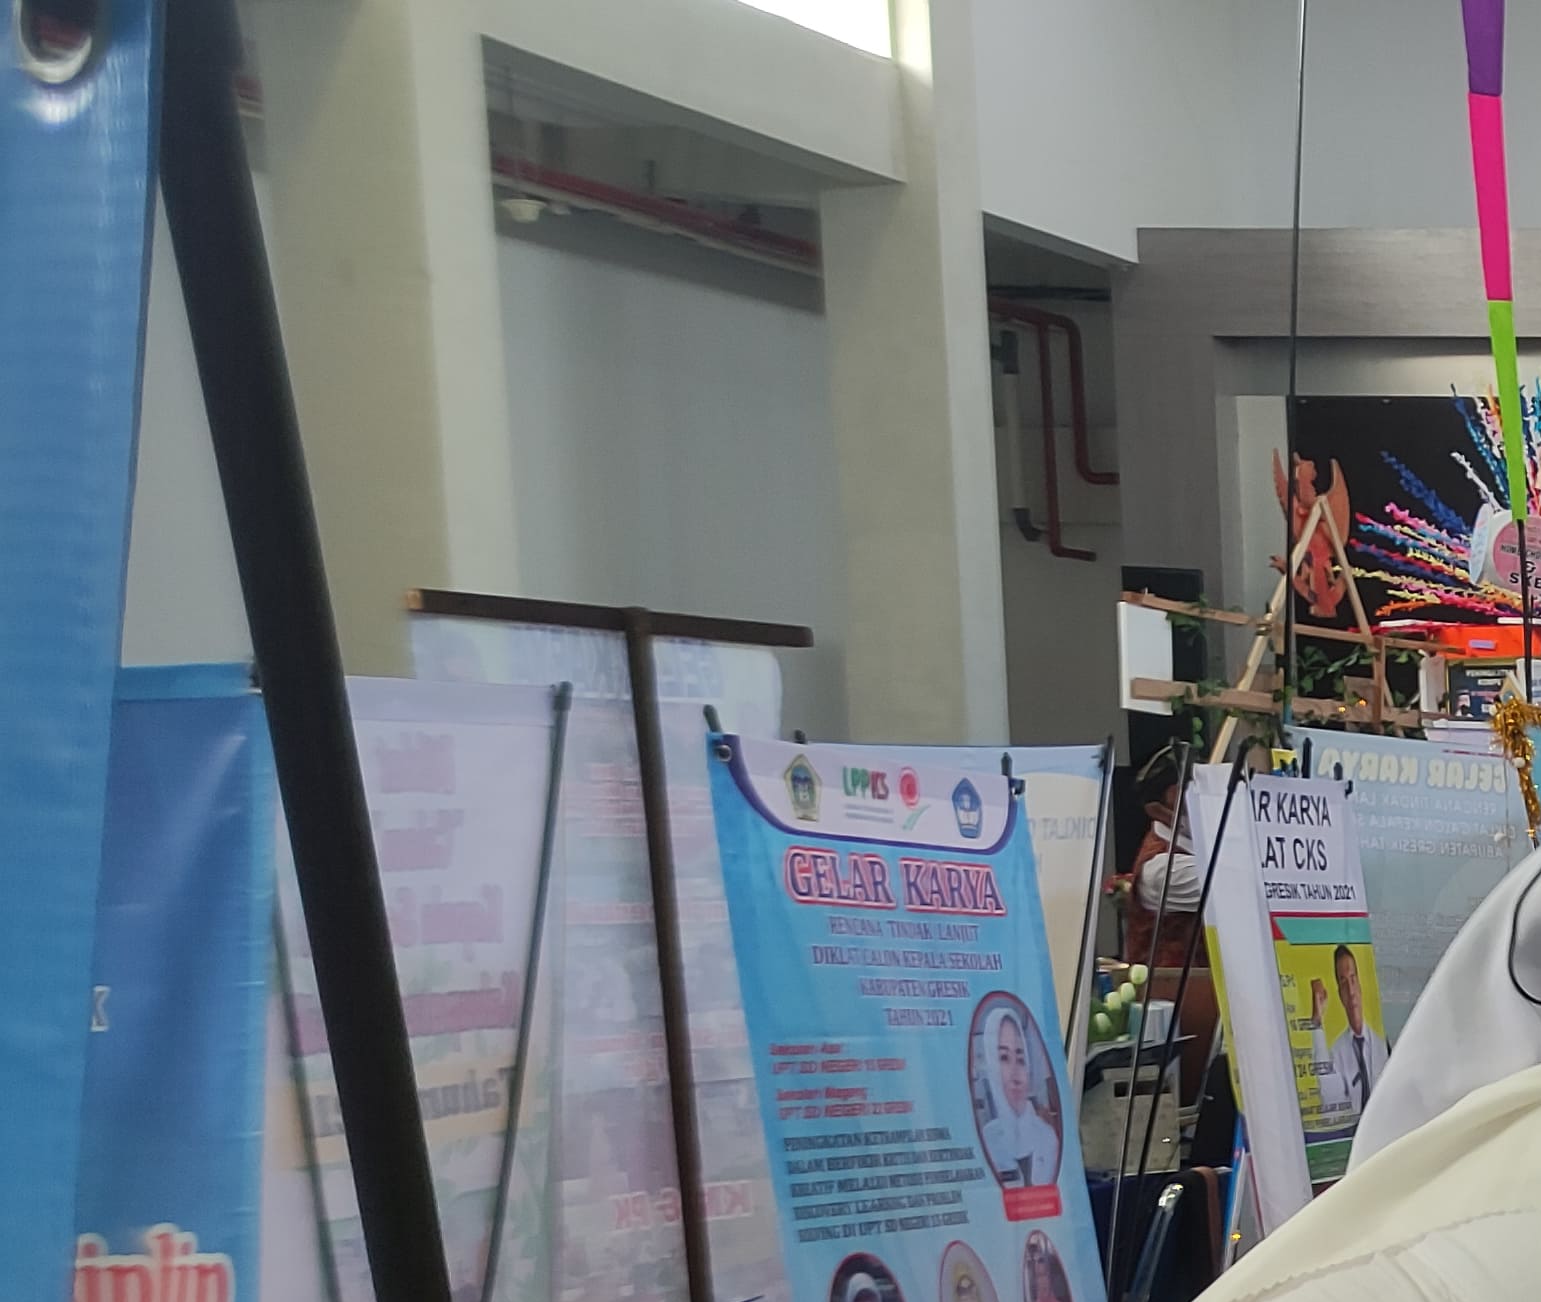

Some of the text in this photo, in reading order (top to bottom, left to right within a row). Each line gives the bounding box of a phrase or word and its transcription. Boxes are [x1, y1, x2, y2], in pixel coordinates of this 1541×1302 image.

[842, 765, 890, 800] LPPKS
[1276, 791, 1332, 827] KARYA
[1292, 837, 1328, 871] CKS
[787, 848, 1007, 914] GELAR KARYA
[1263, 881, 1357, 900] GRESIK TAHUN 2021
